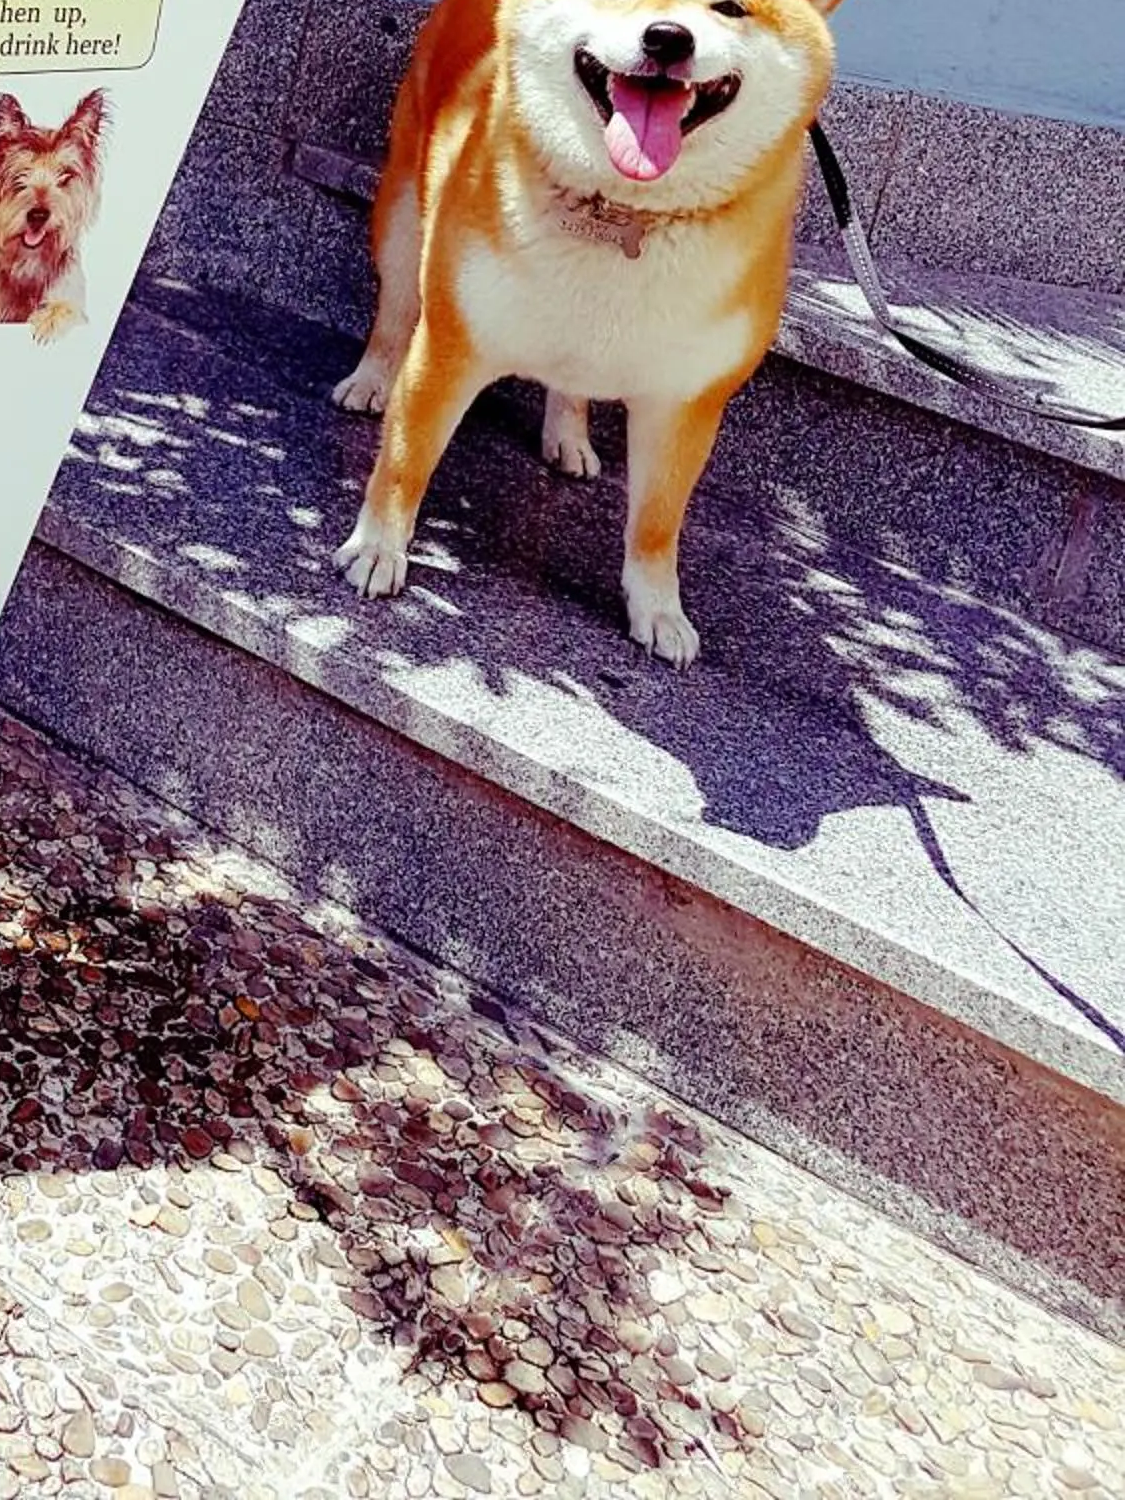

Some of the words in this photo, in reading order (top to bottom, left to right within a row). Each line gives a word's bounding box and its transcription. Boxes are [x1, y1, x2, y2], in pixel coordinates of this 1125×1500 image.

[54, 5, 86, 28] up,
[0, 33, 59, 56] drink
[65, 33, 121, 55] here!
